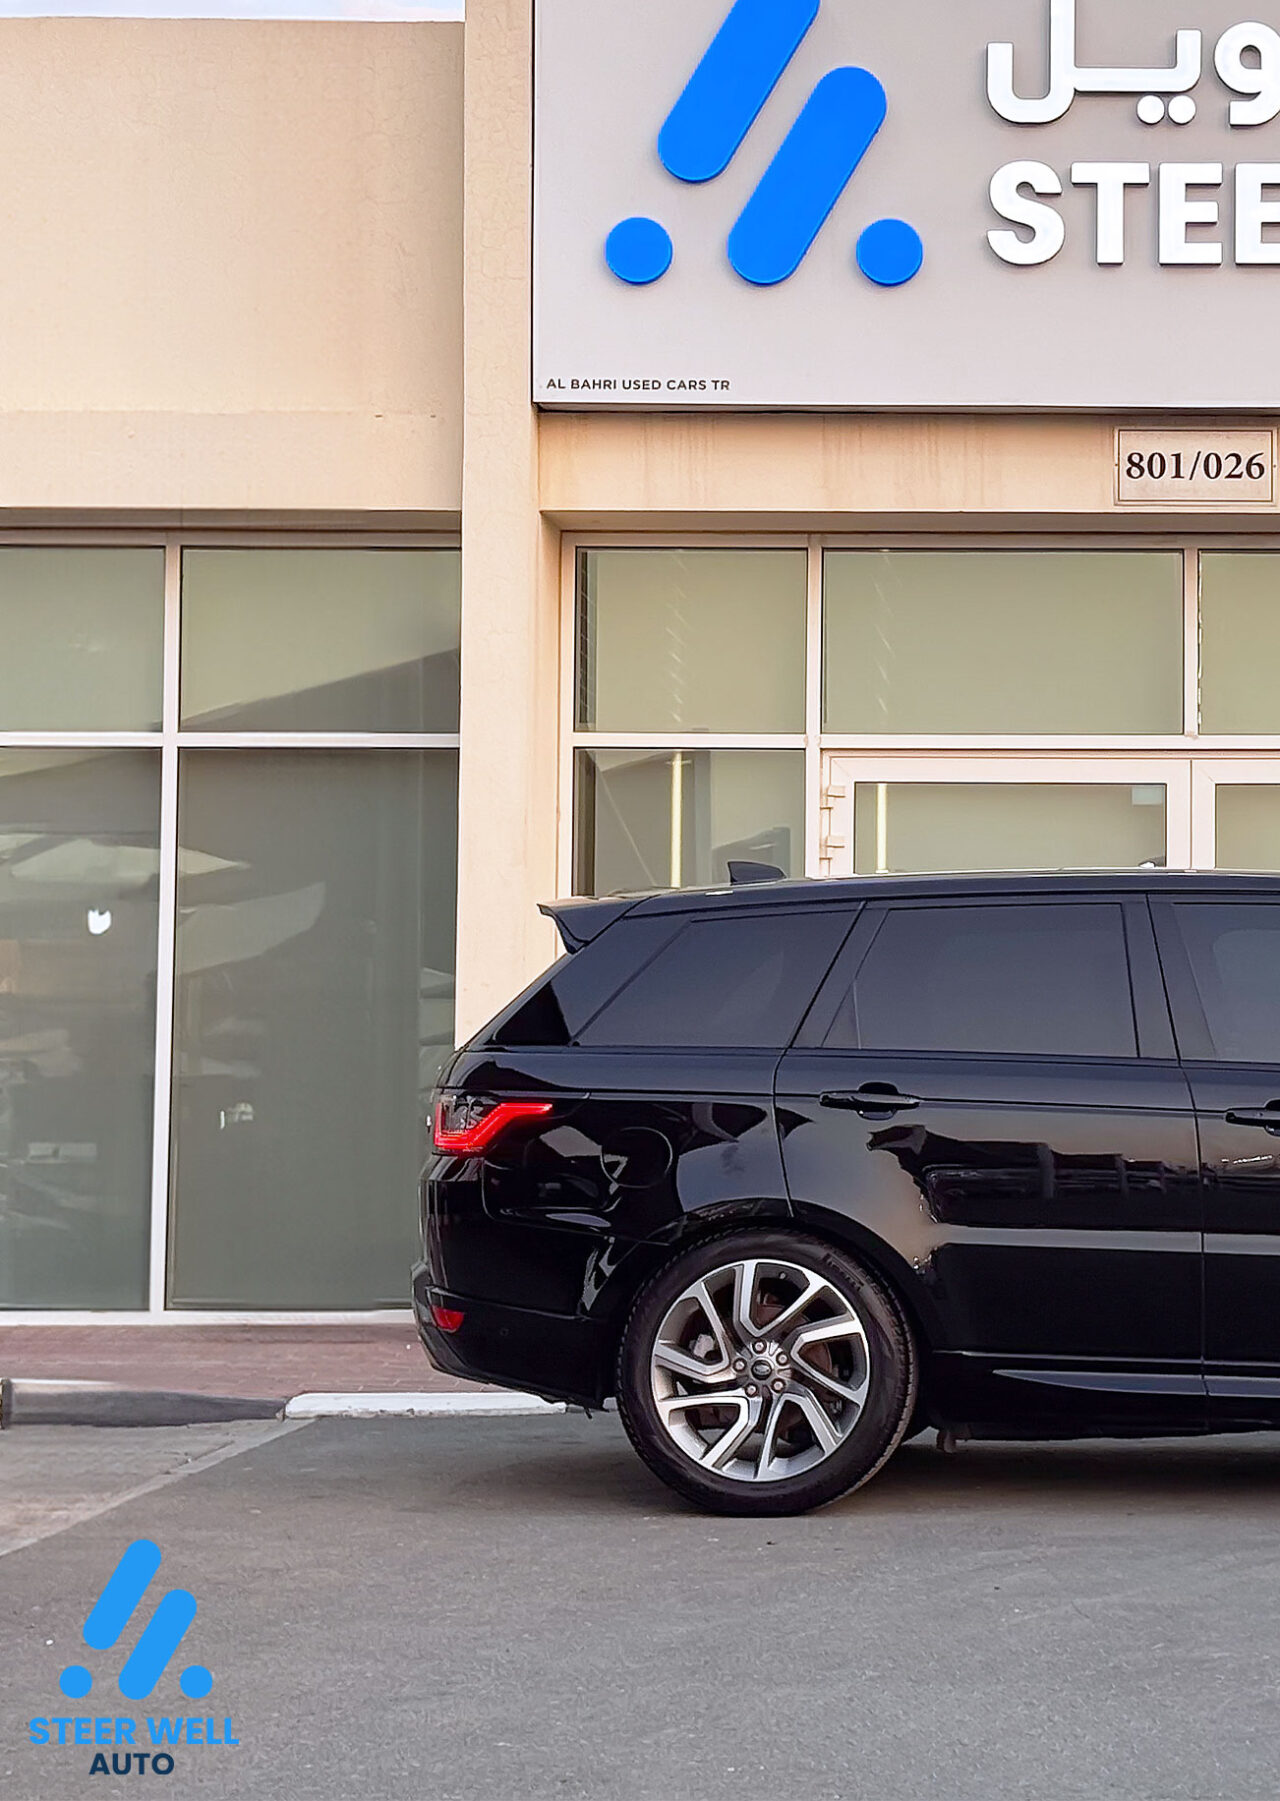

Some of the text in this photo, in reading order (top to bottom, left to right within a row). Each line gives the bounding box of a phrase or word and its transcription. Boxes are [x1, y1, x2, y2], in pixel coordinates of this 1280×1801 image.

[546, 378, 731, 391] AL BAHRI USED CARS TR
[1126, 451, 1265, 480] 801/026
